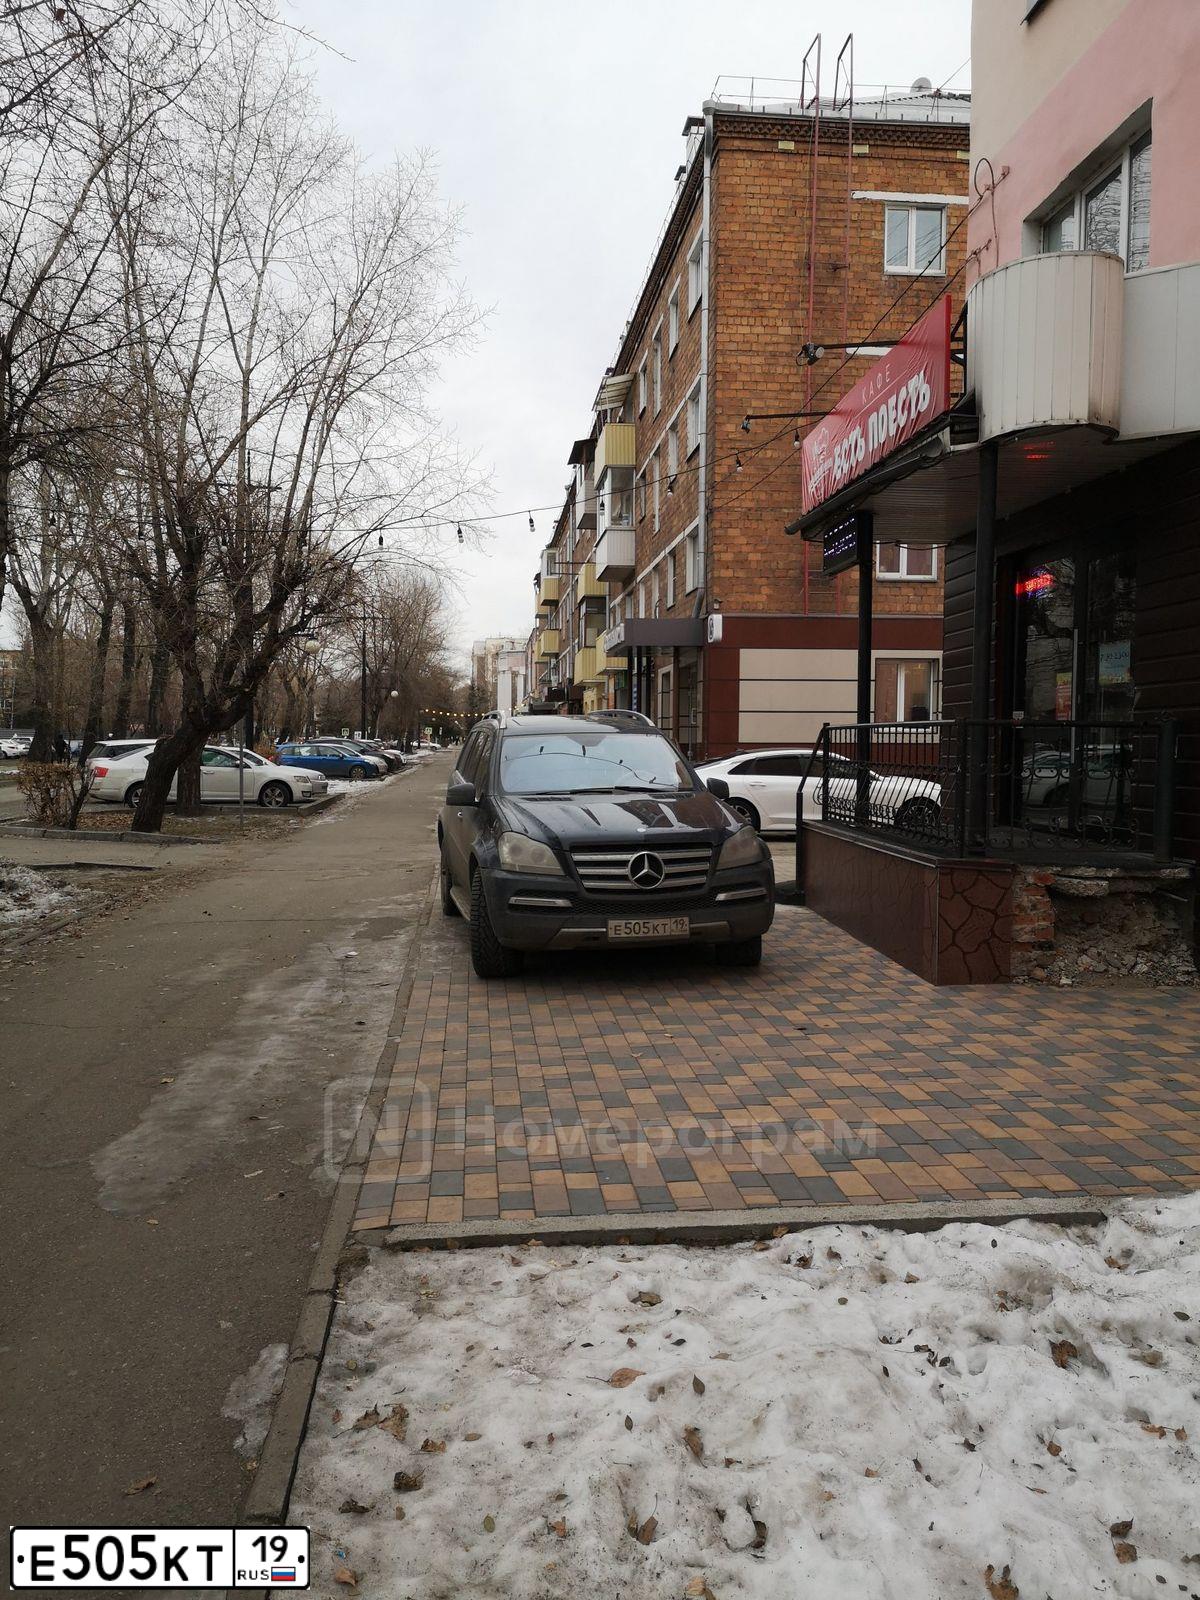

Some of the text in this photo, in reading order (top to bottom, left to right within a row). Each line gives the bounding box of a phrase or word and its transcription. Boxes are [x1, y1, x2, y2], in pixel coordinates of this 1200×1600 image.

[862, 363, 891, 405] КАФЕ
[832, 369, 931, 482] ЕСТЬ ПОЕСТЬ
[613, 918, 685, 935] Е505КТ 19
